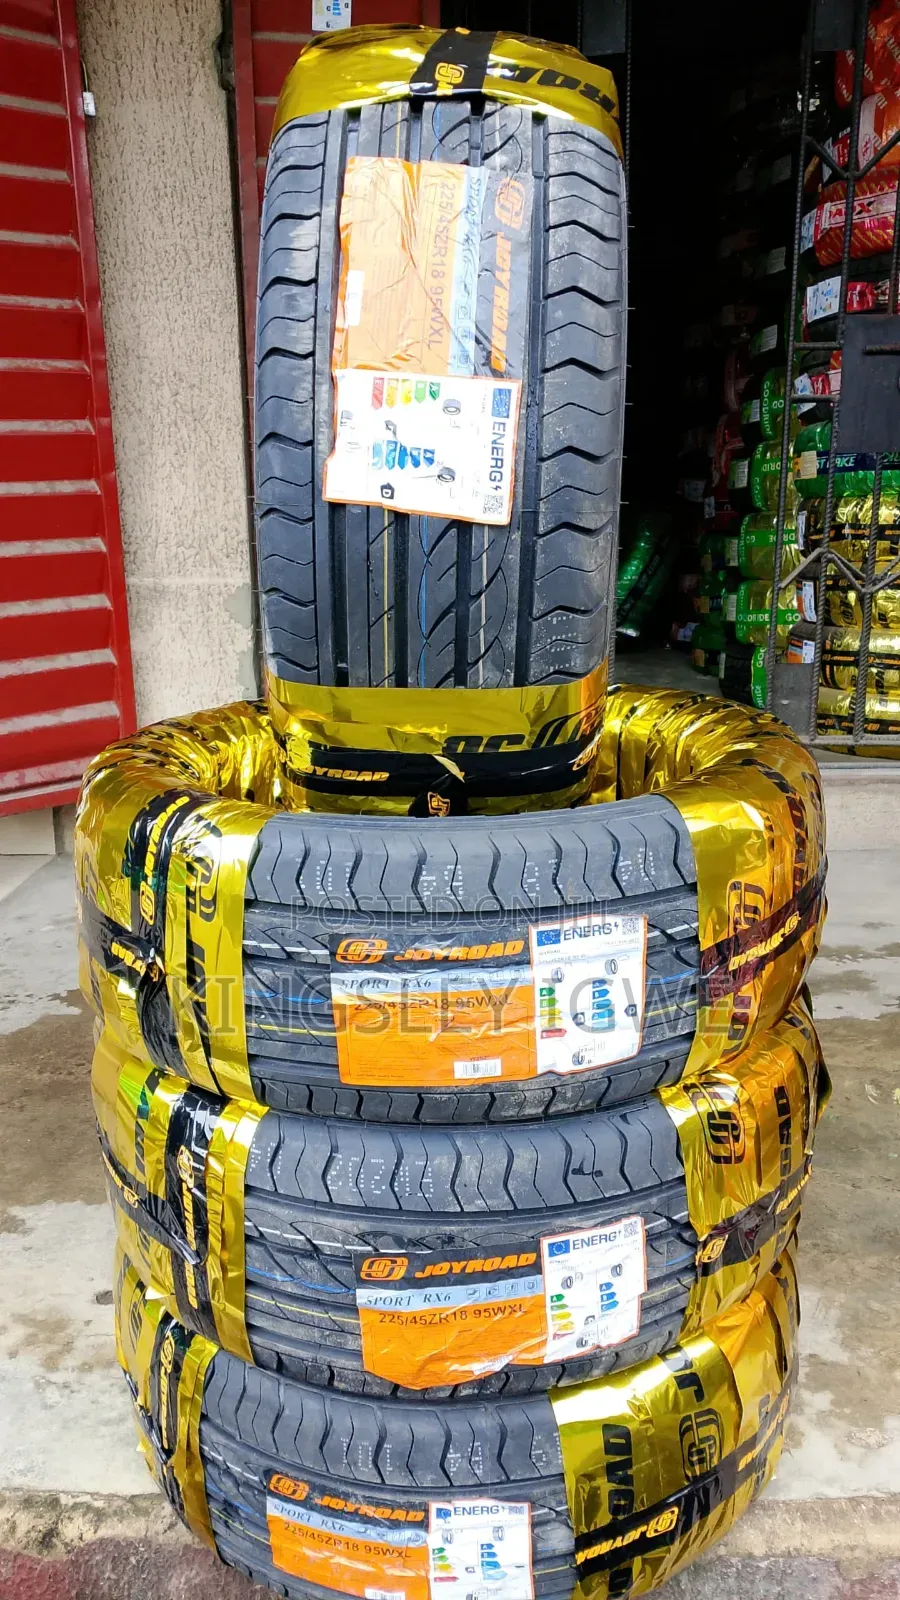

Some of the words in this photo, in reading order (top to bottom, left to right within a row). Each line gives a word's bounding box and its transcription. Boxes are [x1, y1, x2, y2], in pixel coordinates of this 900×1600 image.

[489, 420, 507, 484] ENERG
[563, 923, 612, 941] ENERG
[394, 940, 525, 962] JOYROAD
[340, 978, 391, 991] SPORT
[572, 1231, 617, 1251] ENERG
[414, 1252, 537, 1279] JOYROAD
[364, 1293, 415, 1307] SPORT
[422, 1291, 452, 1304] RX6
[378, 1309, 469, 1327] 225/45ZR18
[473, 1303, 527, 1320] 95WXL
[273, 1503, 314, 1524] SPORT
[320, 1518, 345, 1533] RX6
[315, 1495, 425, 1523] JOYROAD
[453, 1505, 499, 1516] ENERG
[283, 1521, 360, 1552] 225/45ZR18
[364, 1544, 412, 1560] 95WXL
